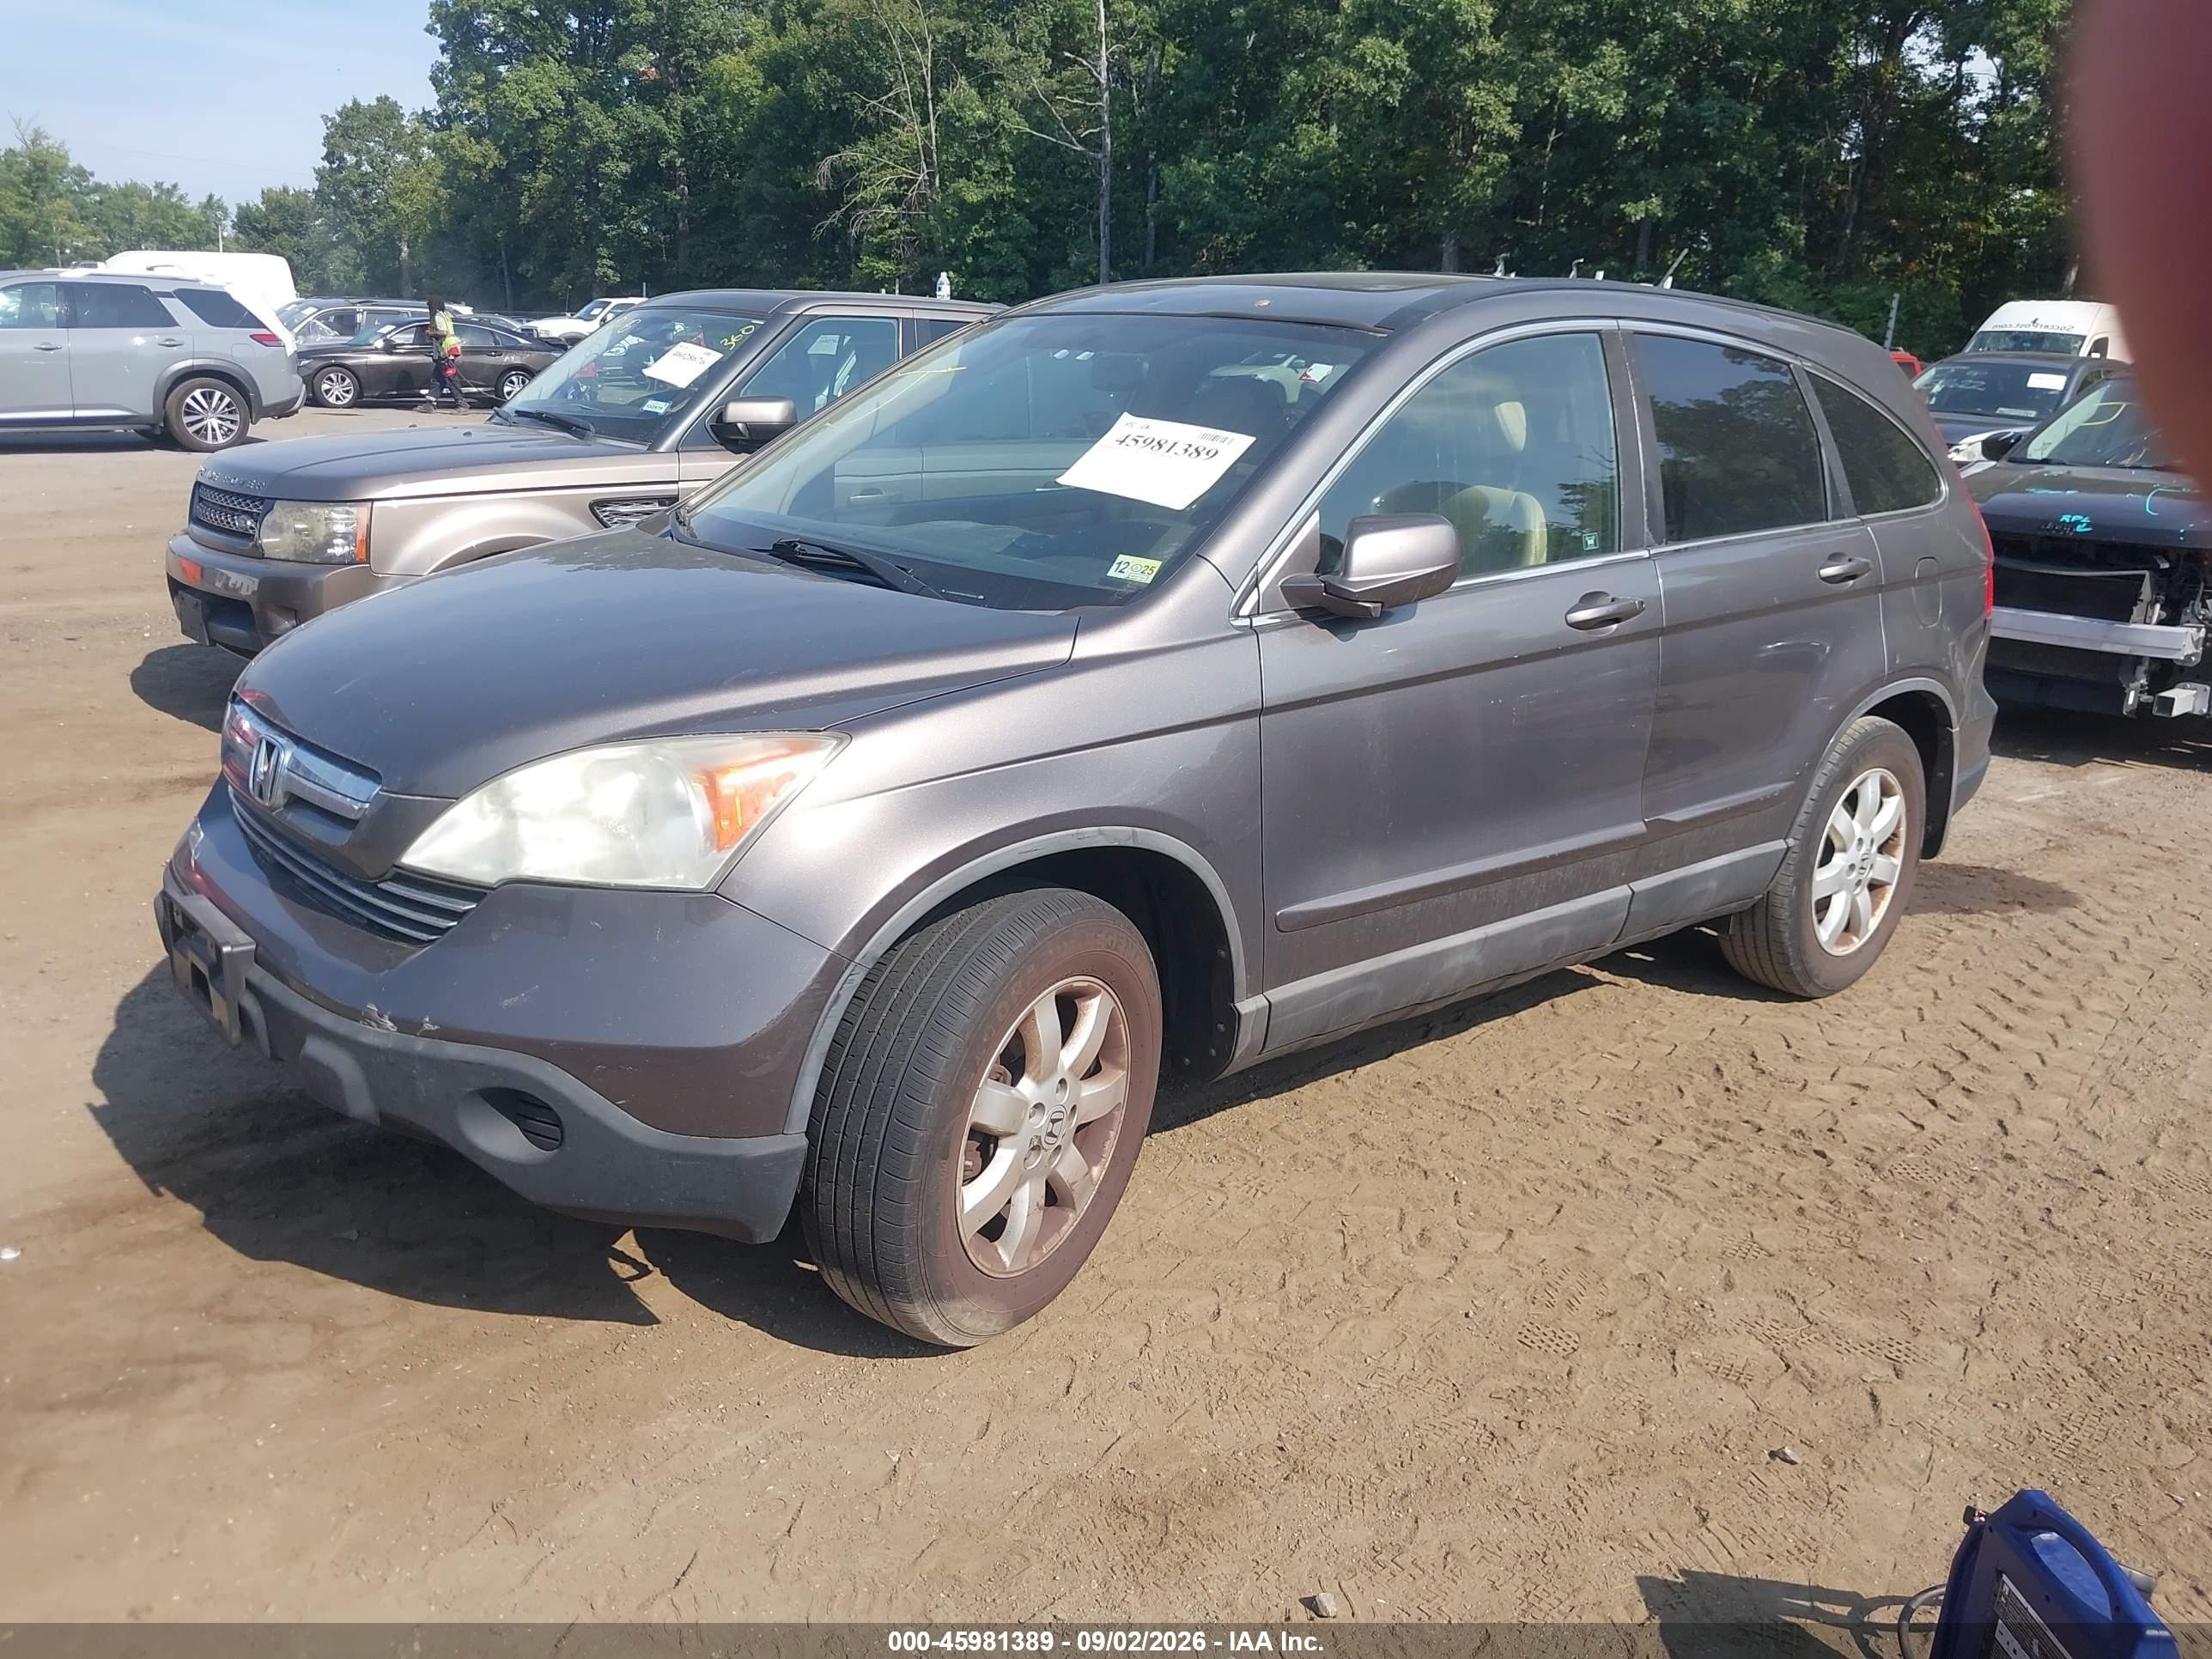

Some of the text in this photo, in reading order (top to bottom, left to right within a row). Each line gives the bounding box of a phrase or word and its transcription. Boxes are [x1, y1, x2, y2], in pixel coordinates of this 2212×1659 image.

[720, 325, 755, 350] 360
[1115, 433, 1220, 461] 45981389
[1114, 560, 1157, 575] 12 25
